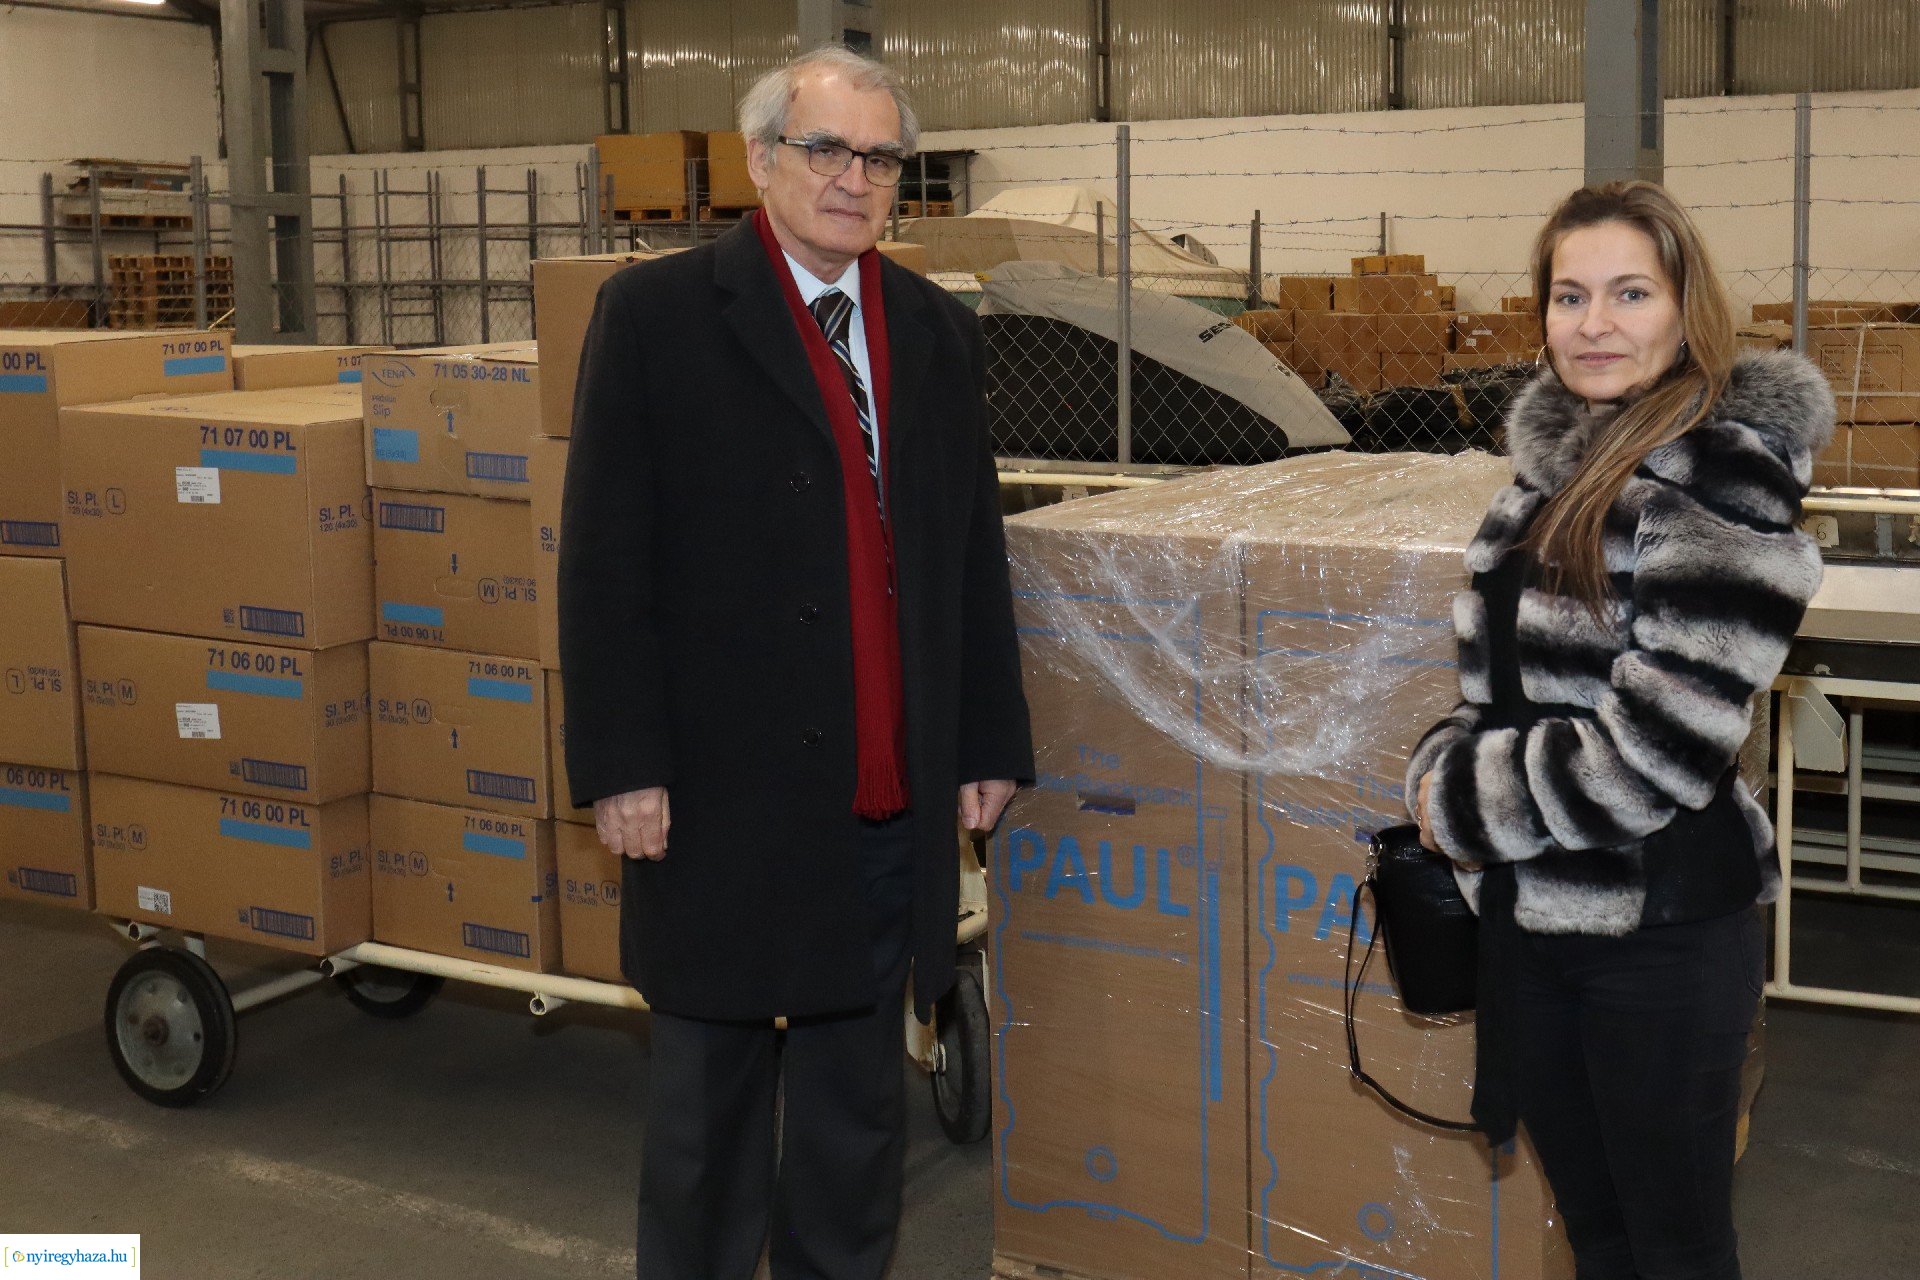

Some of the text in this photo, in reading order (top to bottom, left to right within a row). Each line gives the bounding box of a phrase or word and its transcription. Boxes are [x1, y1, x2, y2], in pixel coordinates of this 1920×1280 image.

[162, 340, 224, 355] 71 07 00 PL
[2, 352, 46, 370] 00 PL
[337, 357, 347, 367] 71
[434, 363, 531, 382] 71 05 30-28 NL
[373, 404, 391, 418] Slip
[200, 426, 296, 451] 71 07 00 PL
[1816, 522, 1827, 540] 6
[483, 584, 495, 597] M
[384, 624, 445, 642] 71 06 00 PL
[207, 648, 303, 676] 71 06 00 PL
[468, 661, 533, 680] 71 06 00 PL
[416, 704, 427, 718] M
[6, 767, 70, 791] 06 00 PL
[219, 797, 310, 827] 71 06 00 PL
[464, 816, 526, 837] 71 06 00 PL
[1007, 827, 1191, 918] PAUL
[605, 886, 617, 900] M
